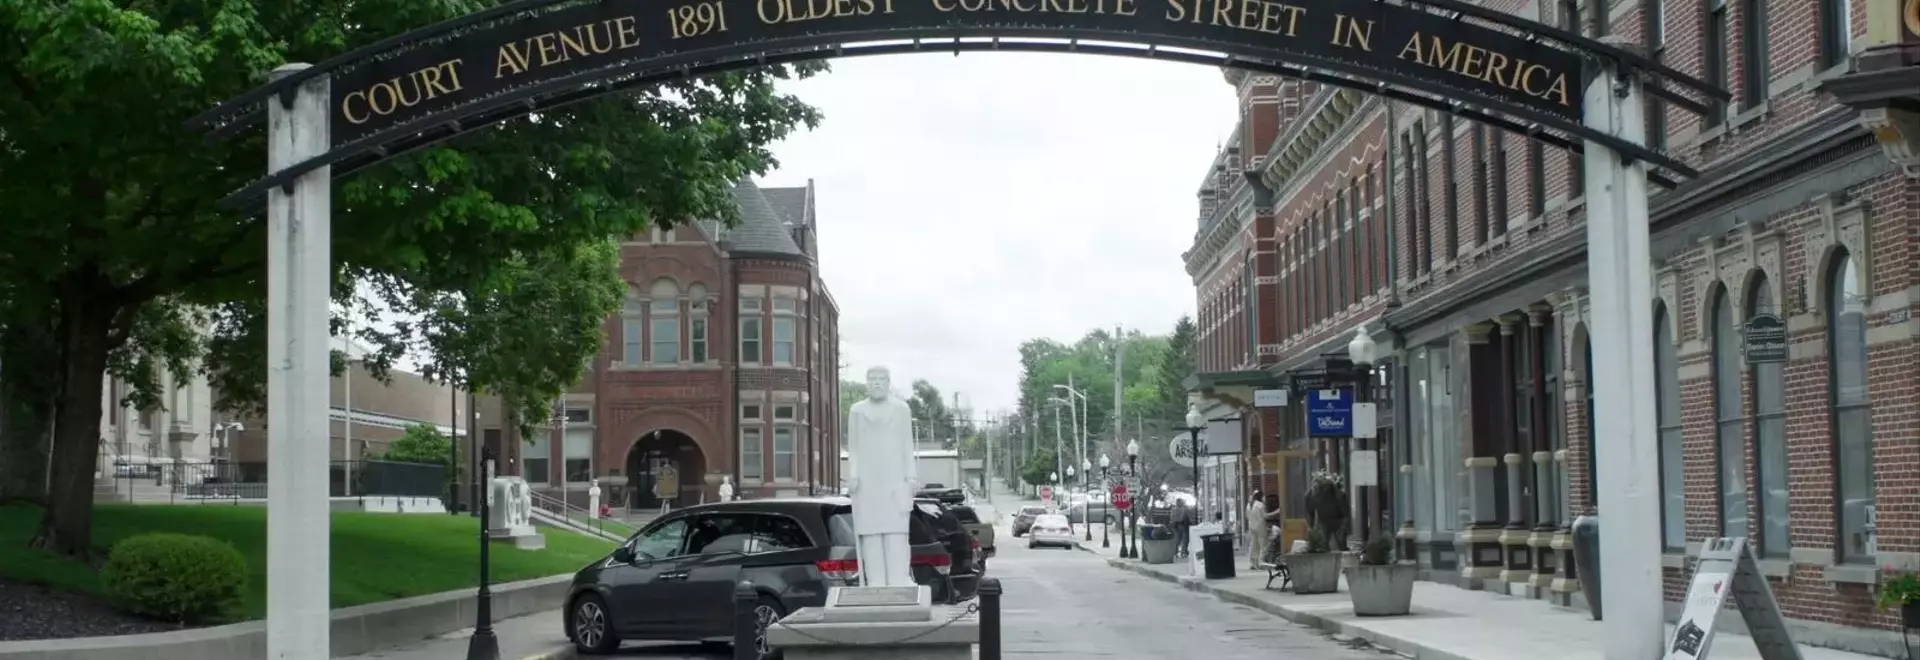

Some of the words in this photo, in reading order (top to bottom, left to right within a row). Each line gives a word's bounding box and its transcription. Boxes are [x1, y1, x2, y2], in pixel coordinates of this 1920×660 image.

[342, 59, 465, 124] COURT
[494, 16, 640, 79] AVENUE
[667, 1, 729, 39] 1891
[1165, 0, 1306, 37] STREET
[1330, 13, 1376, 51] IN
[1396, 30, 1569, 106] AMERICA
